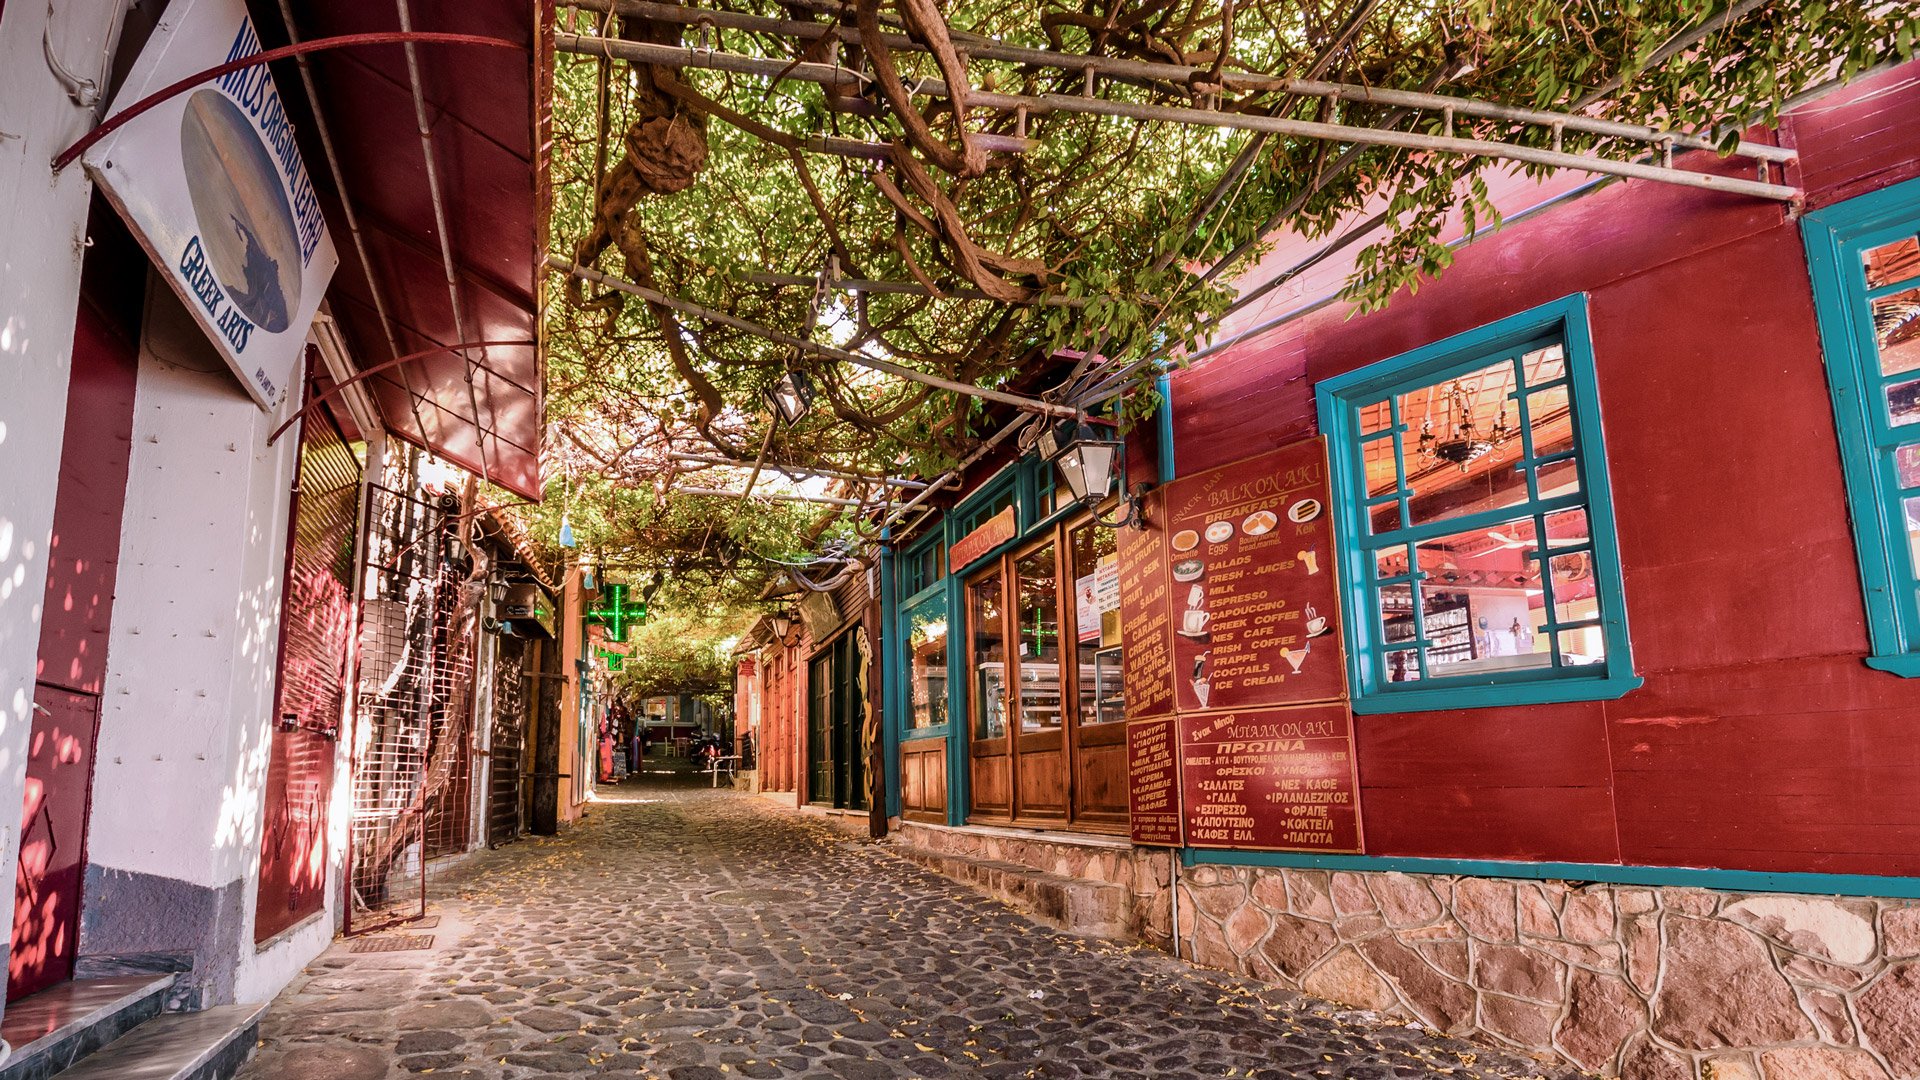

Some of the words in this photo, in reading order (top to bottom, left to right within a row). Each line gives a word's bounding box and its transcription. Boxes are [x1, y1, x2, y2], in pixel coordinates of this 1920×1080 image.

[216, 15, 271, 117] NIKOS
[261, 91, 303, 194] ORIGINAL
[294, 172, 325, 270] LEATHER
[180, 235, 225, 318] GREEK
[217, 304, 255, 354] ARTS
[1208, 463, 1321, 507] BALKONAKI
[1171, 494, 1203, 525] SNACK
[1203, 471, 1224, 493] BAR
[1205, 495, 1289, 525] BREAKFAST
[1121, 529, 1151, 560] YOGURT
[1208, 543, 1229, 557] Eggs
[1119, 560, 1134, 576] with
[1135, 536, 1161, 564] FRUITS
[1208, 555, 1252, 571] SALADS
[1122, 572, 1140, 593] MILK
[1142, 557, 1160, 578] SEIK
[1209, 570, 1244, 584] FRESH
[1253, 560, 1296, 575] JUICES
[1123, 585, 1144, 608] FRUIT
[1140, 584, 1165, 610] SALAD
[1209, 584, 1235, 596] MILK
[1209, 590, 1268, 608] ESPRESSO
[1210, 600, 1286, 621] CAPOUCCINO
[1254, 610, 1300, 625] COFFEE
[1123, 611, 1148, 635] CREME
[1132, 612, 1168, 642] CARAMEL
[1212, 632, 1234, 643] NES
[1243, 626, 1274, 639] CAFE
[1128, 630, 1162, 658] CREPPES
[1213, 643, 1242, 655] IRISH
[1251, 635, 1297, 649] COFFEE
[1129, 643, 1164, 672] WAFFLES
[1213, 653, 1258, 667] FRAPPE
[1127, 671, 1140, 684] Our
[1143, 655, 1167, 675] coffee
[1135, 673, 1154, 691] fresh
[1158, 661, 1172, 678] and
[1213, 663, 1270, 678] COCTAILS
[1215, 680, 1234, 690] ICE
[1243, 674, 1285, 687] CREAM
[1126, 697, 1151, 719] ground
[1136, 723, 1167, 740] ΓΙΑΟΥΡΤΙ
[1191, 728, 1212, 741] Σνακ
[1213, 714, 1235, 731] Μπαρ
[1136, 732, 1167, 748] ΓΙΑΟΥΡΤΙ
[1216, 740, 1306, 754] ΠΡΩΙΝΑ
[1137, 748, 1147, 758] ΜΕ
[1150, 742, 1166, 753] ΜΕΛΙ
[1214, 755, 1230, 765] ΑΥΓΑ
[1141, 771, 1164, 784] ΚΡΕΜΑ
[1202, 779, 1245, 791] ΣΑΛΑΤΕΣ
[1281, 779, 1300, 790] ΝΕΣ
[1306, 779, 1337, 790] ΚΑΦΕ
[1135, 779, 1171, 794] ΚΑΡΑΜΕΛΕ
[1140, 789, 1167, 802] ΚΡΕΠΕΣ
[1211, 792, 1237, 803] ΓΑΛΑ
[1271, 792, 1349, 804] ΙΡΛΑΝΔΕΖΙΚΟΣ
[1201, 804, 1247, 816] ΕΣΠΡΕΣΣΟ
[1291, 805, 1328, 817] ΦΡΑΠΕ
[1196, 817, 1255, 828] ΚΑΠΟΥΤΣΙΝΟ
[1286, 817, 1334, 830] ΚΟΚΤΕΪΛ
[1197, 829, 1230, 840] ΚΑΦΕΣ
[1233, 830, 1255, 841] ΕΛΛ.
[1289, 832, 1333, 844] ΠΑΓΩΤΑ
